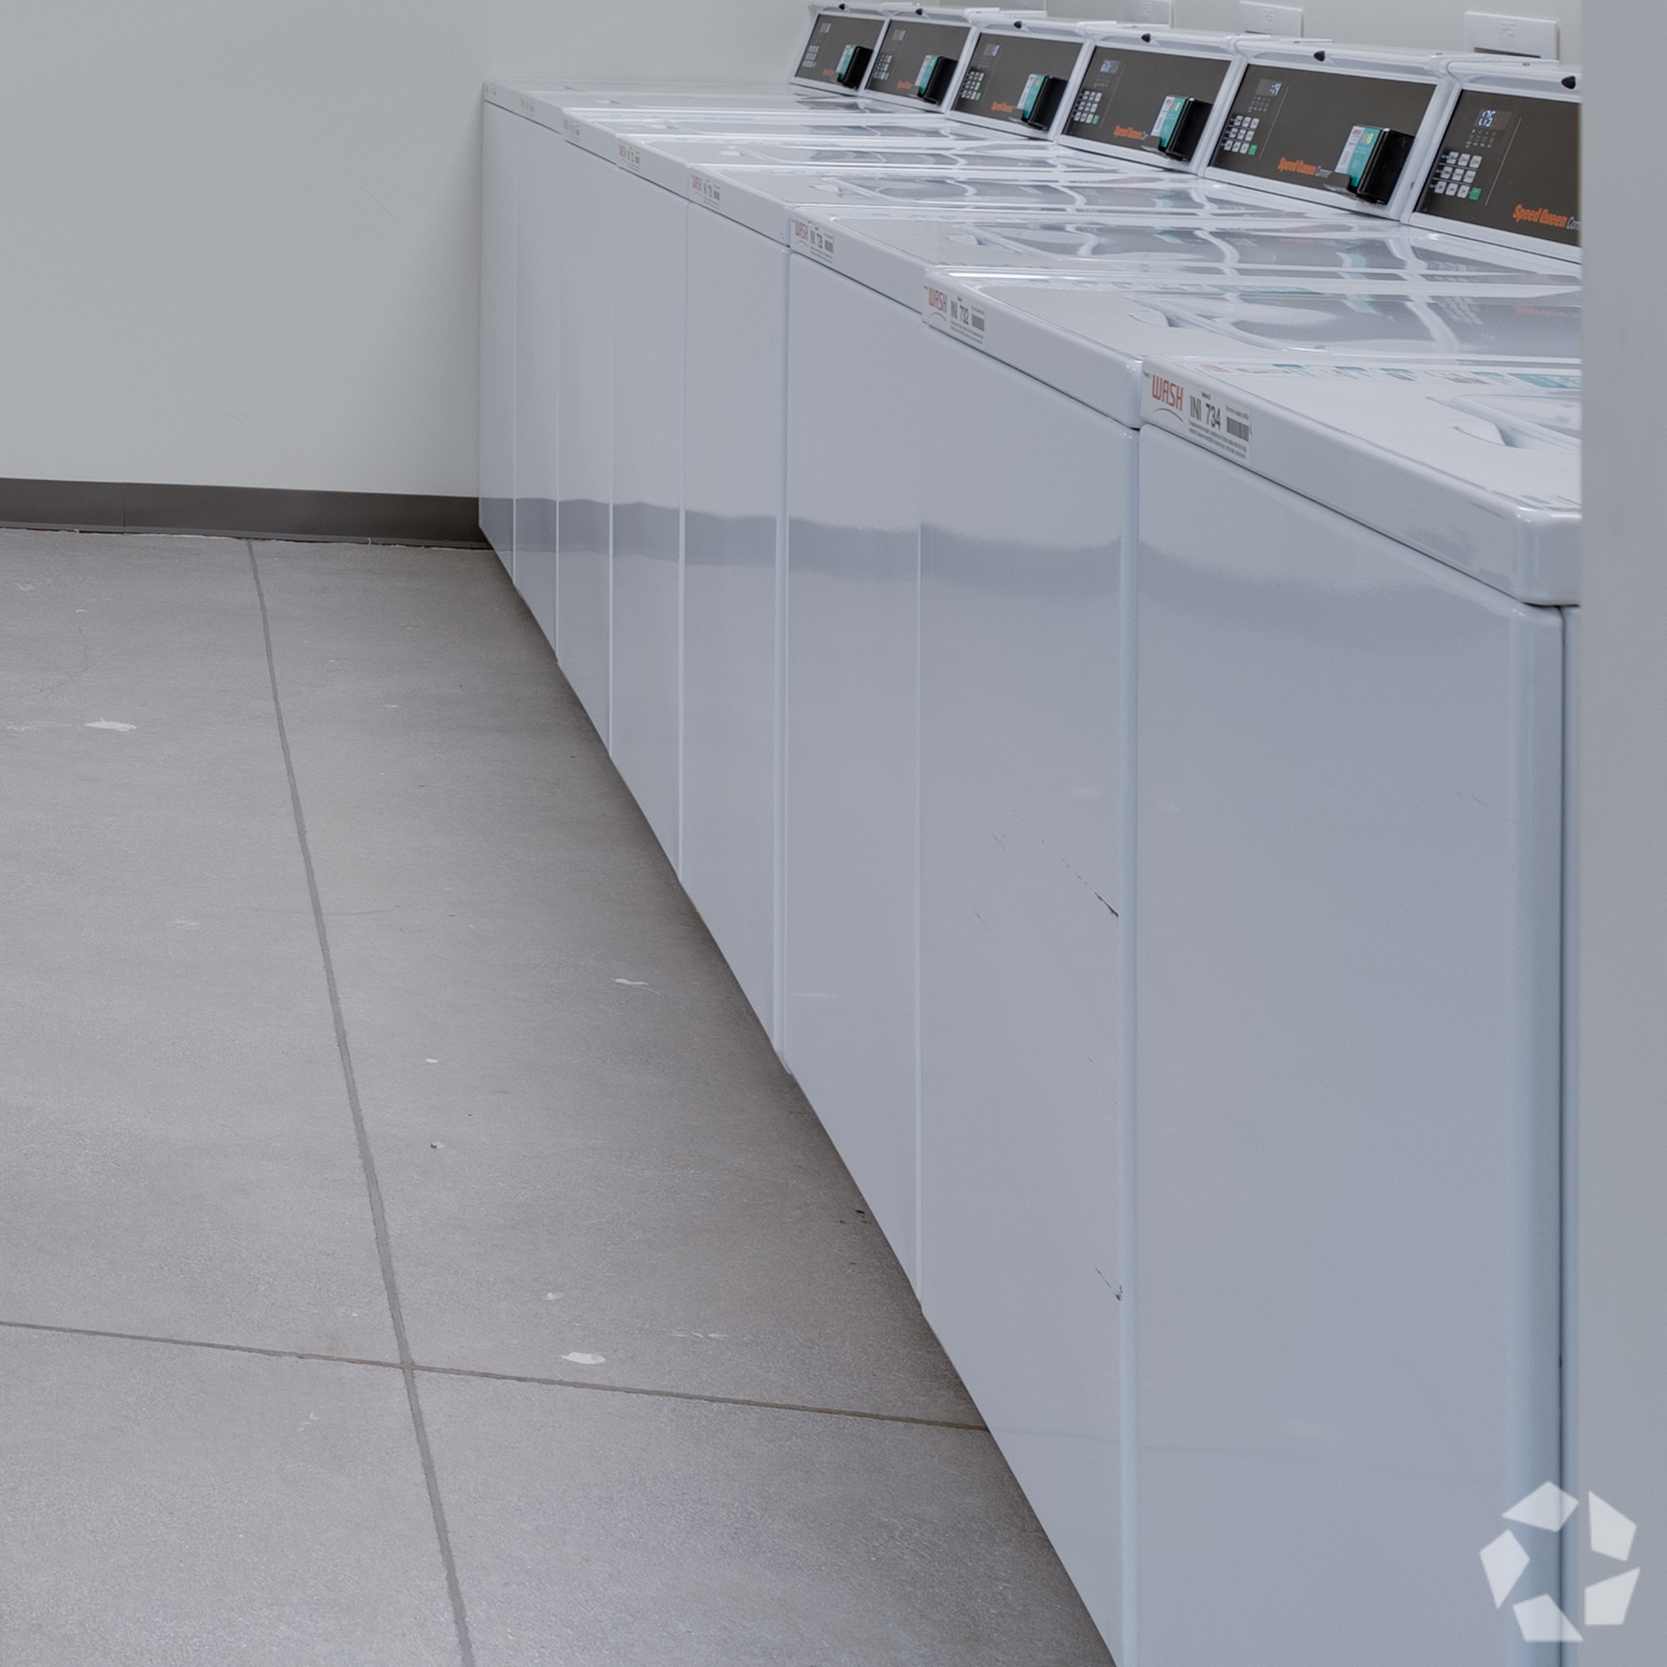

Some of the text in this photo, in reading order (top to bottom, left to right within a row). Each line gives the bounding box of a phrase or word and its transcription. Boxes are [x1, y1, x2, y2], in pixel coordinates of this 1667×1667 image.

[1512, 203, 1541, 223] Speed
[1539, 207, 1568, 228] Queen
[1152, 374, 1184, 412] WASH
[1205, 402, 1222, 431] 734
